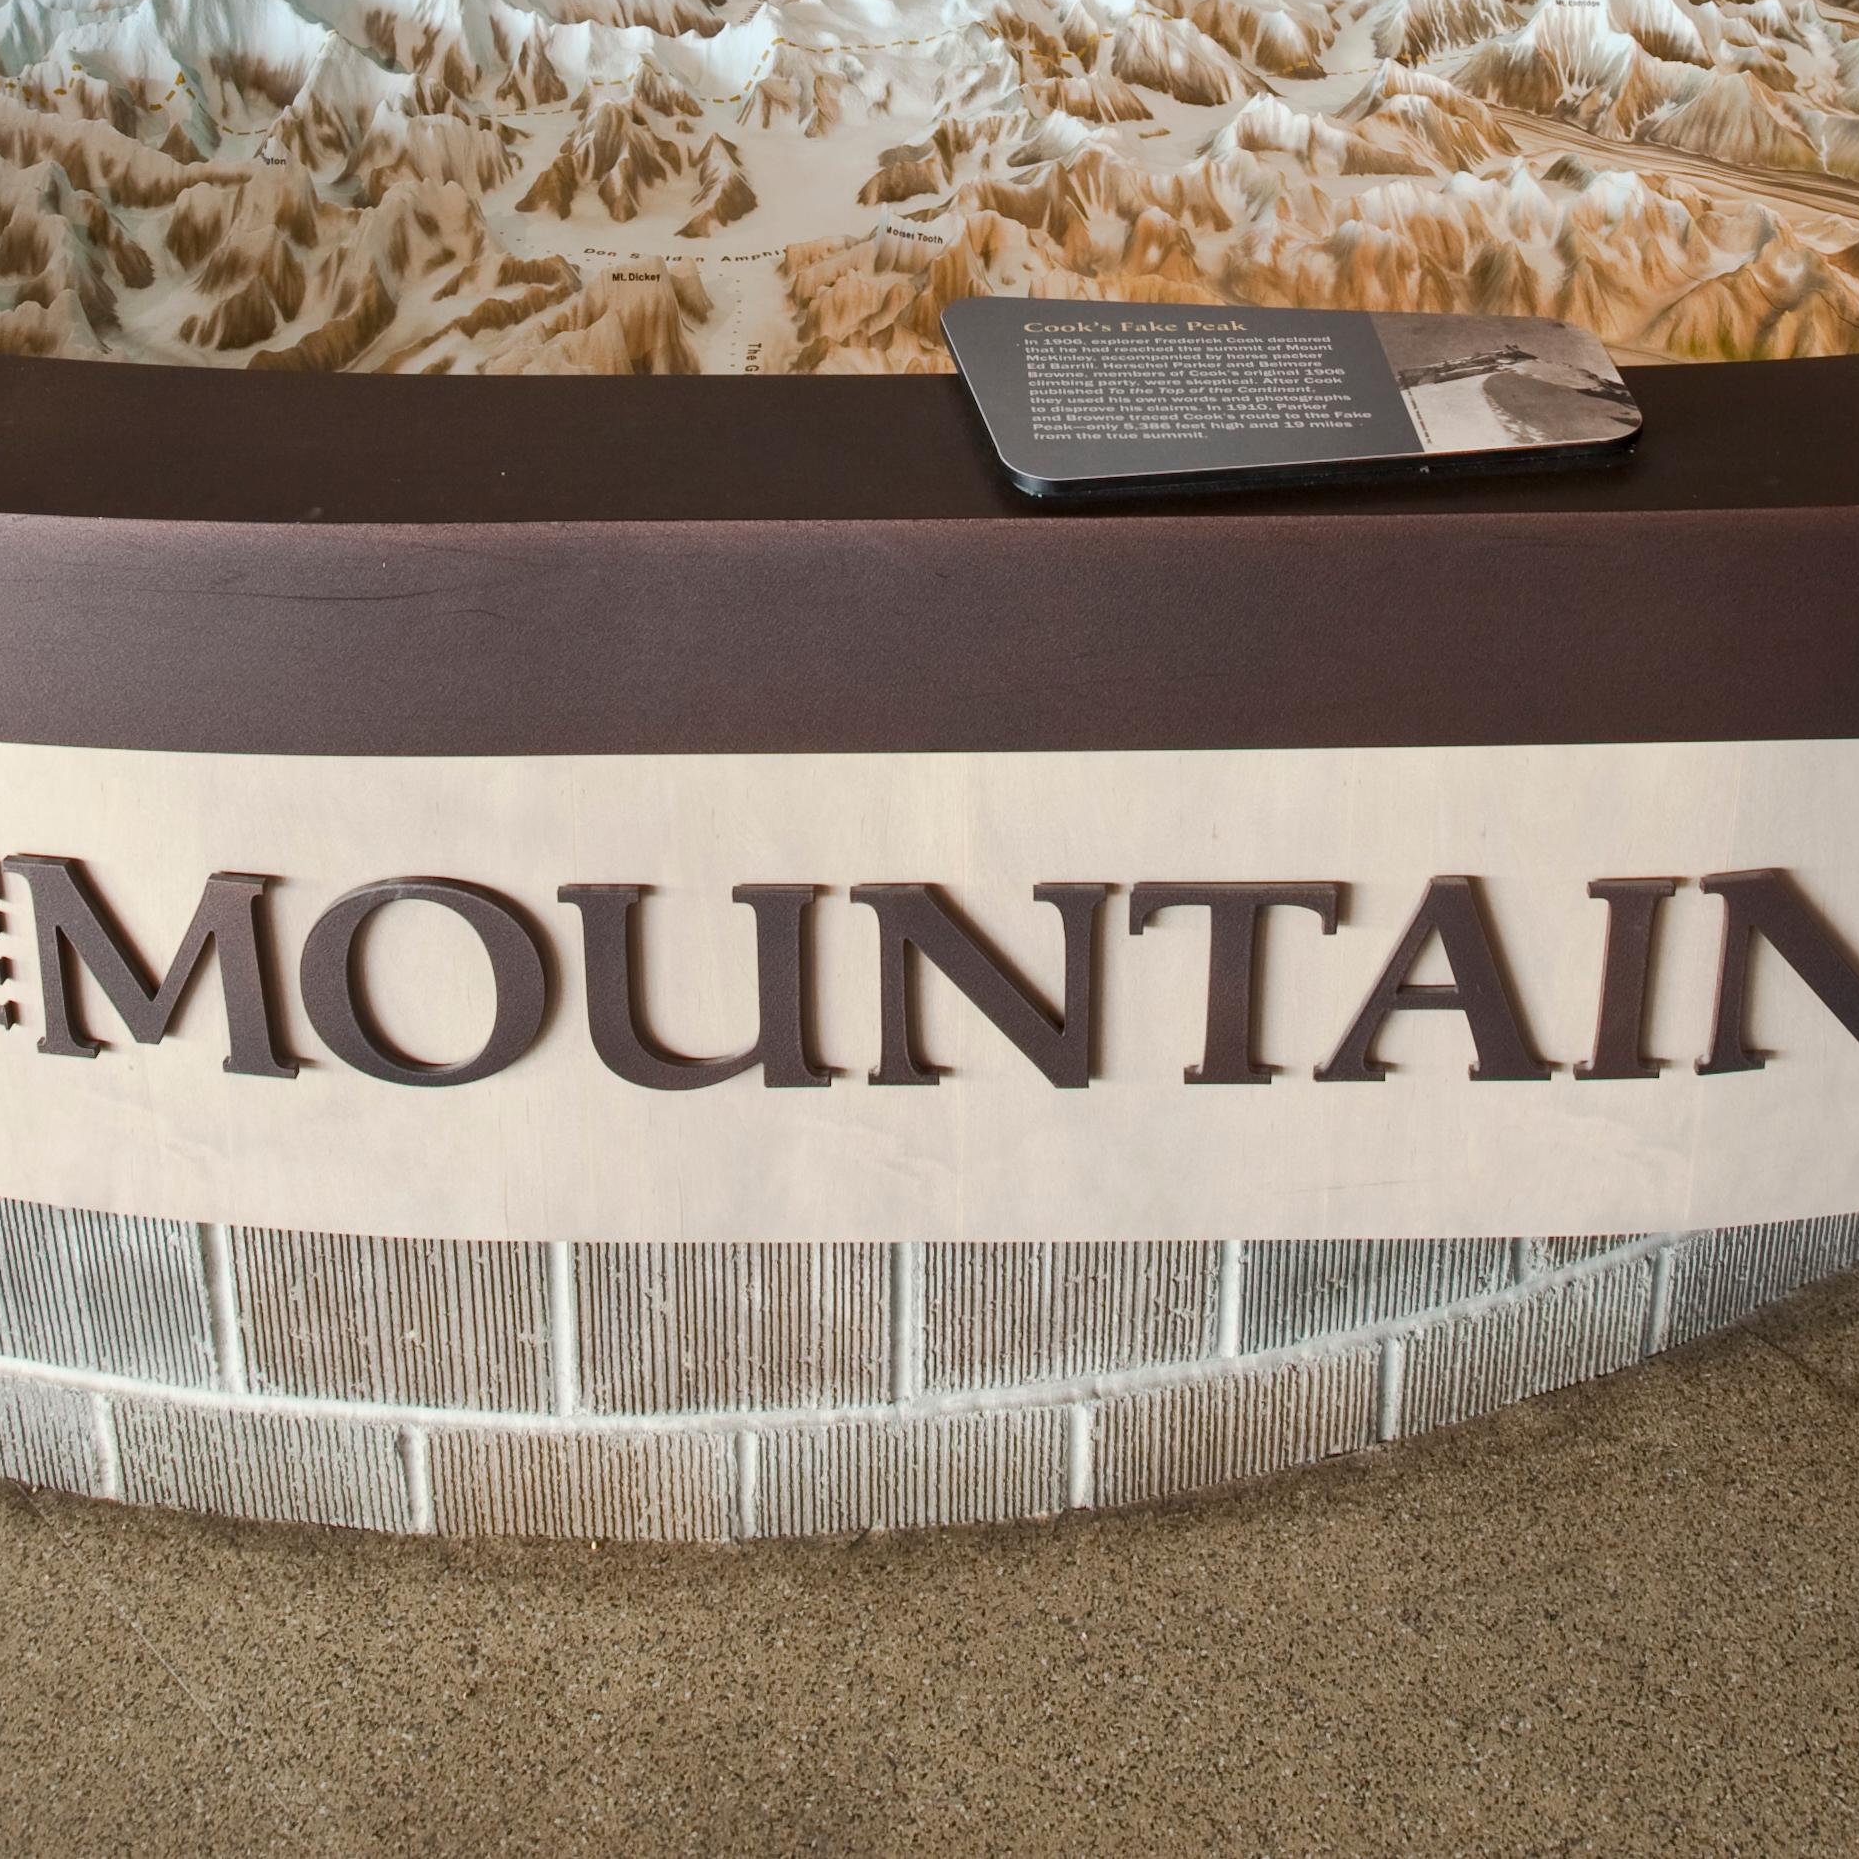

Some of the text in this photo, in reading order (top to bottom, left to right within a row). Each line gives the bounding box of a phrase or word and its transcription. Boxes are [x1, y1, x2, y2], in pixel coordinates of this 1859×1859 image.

[1024, 321, 1248, 332] Cook's Fake Peak
[1092, 338, 1149, 346] explorer
[1026, 355, 1096, 363] McKinley,
[1206, 353, 1222, 361] by
[1028, 371, 1088, 379] Browne,
[1244, 369, 1299, 377] original
[1029, 380, 1094, 388] climbing
[1186, 378, 1258, 386] skeptical.
